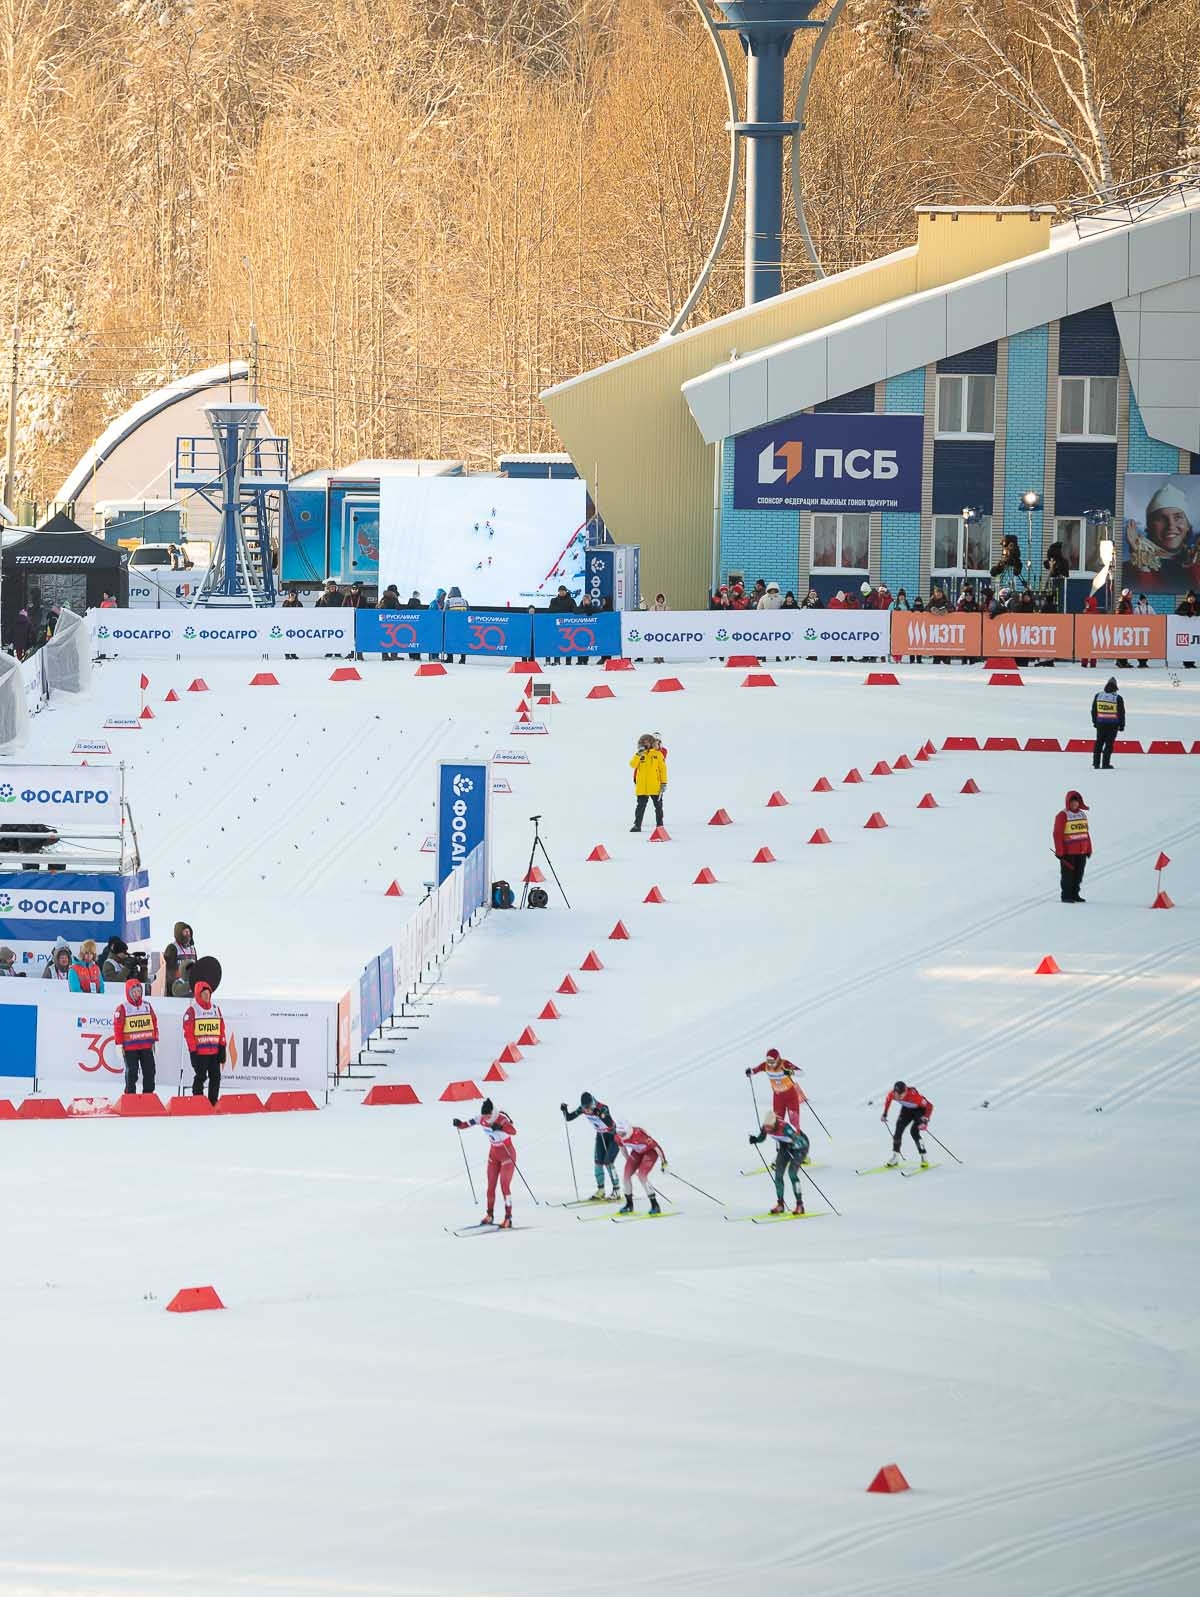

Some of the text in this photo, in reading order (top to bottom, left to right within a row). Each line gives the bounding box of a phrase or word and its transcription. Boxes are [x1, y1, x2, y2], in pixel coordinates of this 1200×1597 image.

[814, 448, 899, 479] ПСБ
[757, 497, 898, 507] СПОНСОР ФЕДЕРАЦИИ ЛЫЖНЫХ ГОНОК УДМУРТИИ
[112, 630, 171, 640] ФОСАГРО
[199, 630, 258, 640] ФОСАГРО
[285, 628, 344, 639] ФОСАГРО
[380, 623, 417, 648] 30
[468, 625, 505, 650] 30
[557, 626, 595, 652] 30
[643, 632, 703, 643] ФОСАГРО
[731, 631, 791, 642] ФОСАГРО
[820, 631, 880, 641] ФОСАГРО
[929, 624, 966, 644] ИЗТТ
[1020, 625, 1057, 646] ИЗТТ
[1113, 626, 1150, 647] ИЗТТ
[20, 789, 109, 804] ФОСАГРО
[18, 899, 106, 915] ФОСАГРО
[129, 1018, 151, 1029] СУДЬЯ
[198, 1023, 219, 1032] СУДЬЯ
[242, 1037, 300, 1068] ИЗТТ
